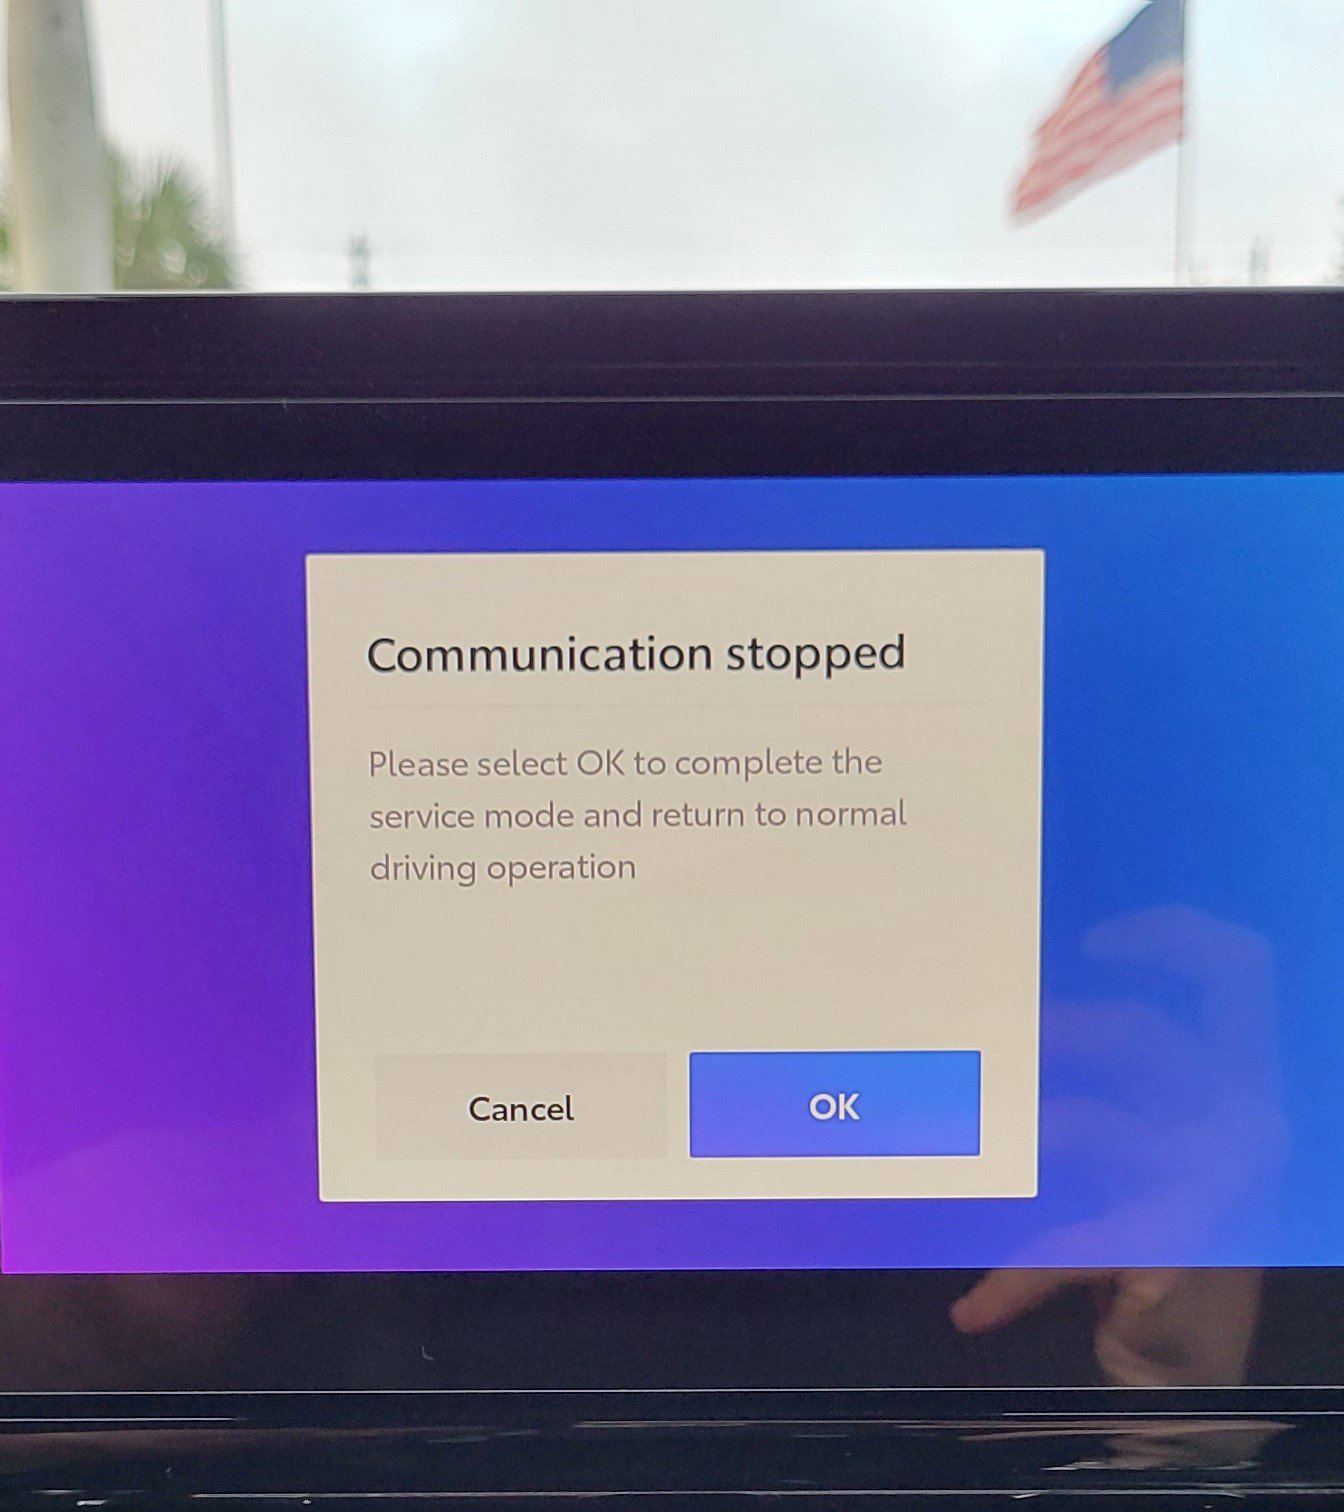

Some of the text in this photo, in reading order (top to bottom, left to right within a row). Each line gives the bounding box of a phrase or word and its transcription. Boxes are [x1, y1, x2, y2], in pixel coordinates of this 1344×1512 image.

[368, 633, 906, 679] Communication stopped
[369, 746, 882, 782] Please select OK to complete the
[370, 799, 906, 830] service mode and return to normal
[370, 853, 636, 887] driving operation
[468, 1095, 575, 1122] Cancel
[809, 1092, 860, 1121] OK
